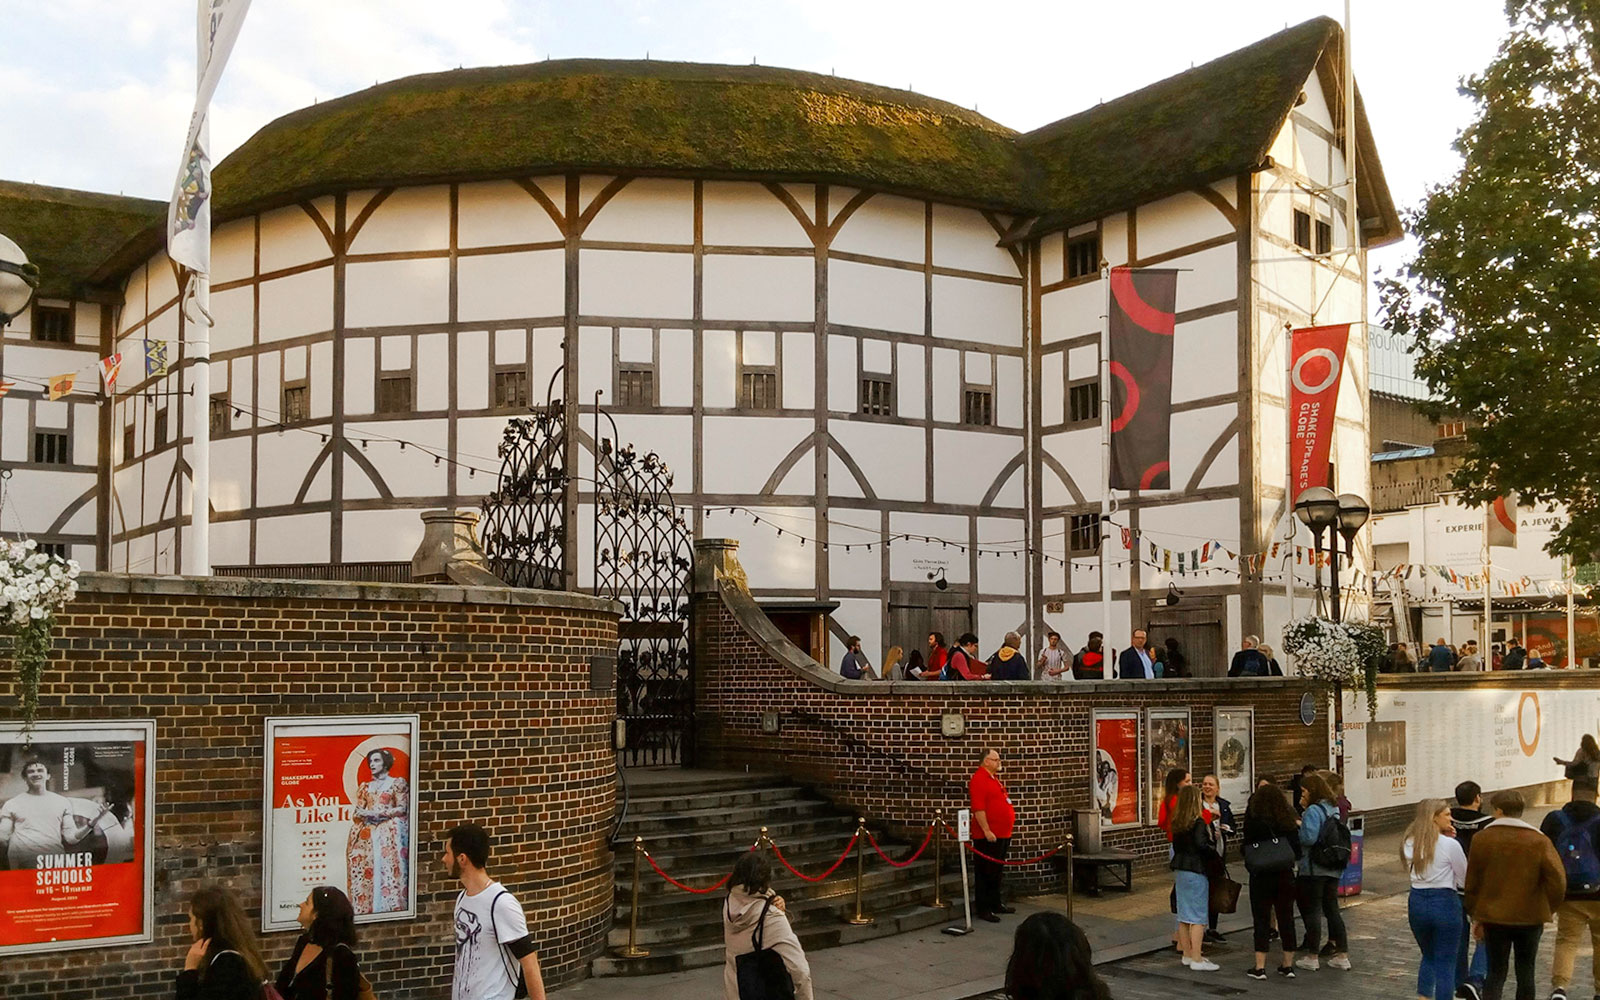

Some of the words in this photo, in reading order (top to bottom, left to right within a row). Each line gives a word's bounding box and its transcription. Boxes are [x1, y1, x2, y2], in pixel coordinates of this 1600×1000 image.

[1296, 402, 1310, 439] GLOBE
[1299, 402, 1320, 488] SHAKESPEARE'S
[1445, 523, 1483, 534] EXPERIE
[1520, 519, 1528, 527] A
[1368, 767, 1381, 779] 700
[1380, 765, 1406, 778] TICKETS
[1391, 777, 1399, 789] AT
[281, 794, 305, 808] As
[308, 792, 340, 807] You
[295, 808, 334, 824] Like
[337, 806, 351, 822] It
[36, 852, 93, 870] SUMMER
[36, 868, 93, 886] SCHOOLS
[46, 886, 54, 894] 16
[61, 885, 70, 893] 19
